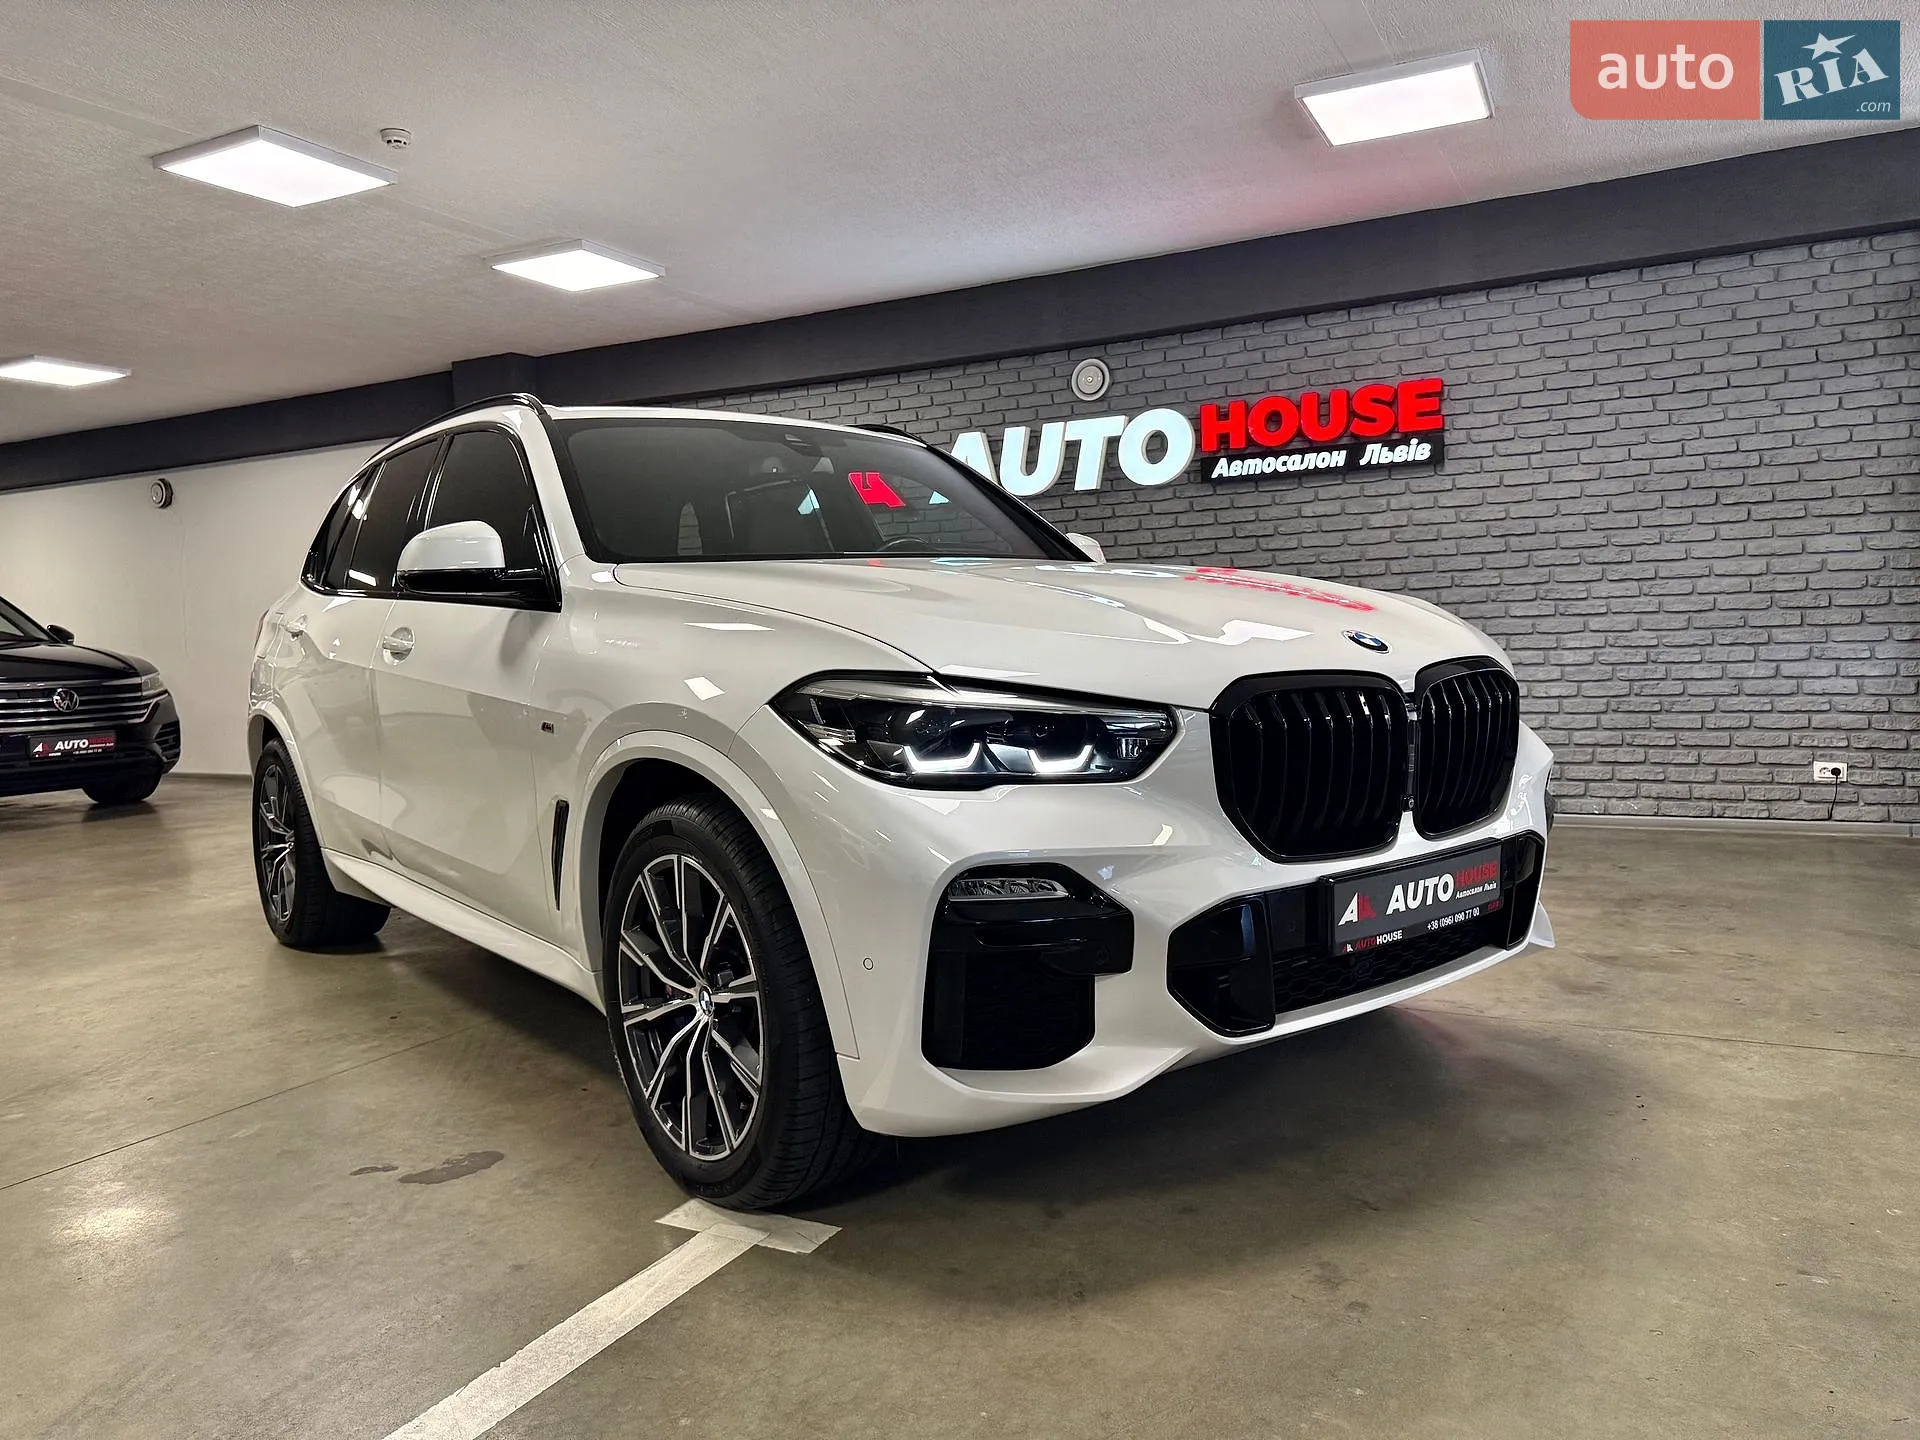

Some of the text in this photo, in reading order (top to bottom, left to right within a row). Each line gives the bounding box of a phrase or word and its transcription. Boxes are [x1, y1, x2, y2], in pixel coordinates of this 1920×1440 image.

[950, 378, 1445, 497] AUTO HOUSE
[1211, 438, 1432, 479] Автосалон Львів
[54, 739, 89, 751] AUTO
[1385, 860, 1498, 916] AUTO HOUSE
[1427, 919, 1439, 931] +38
